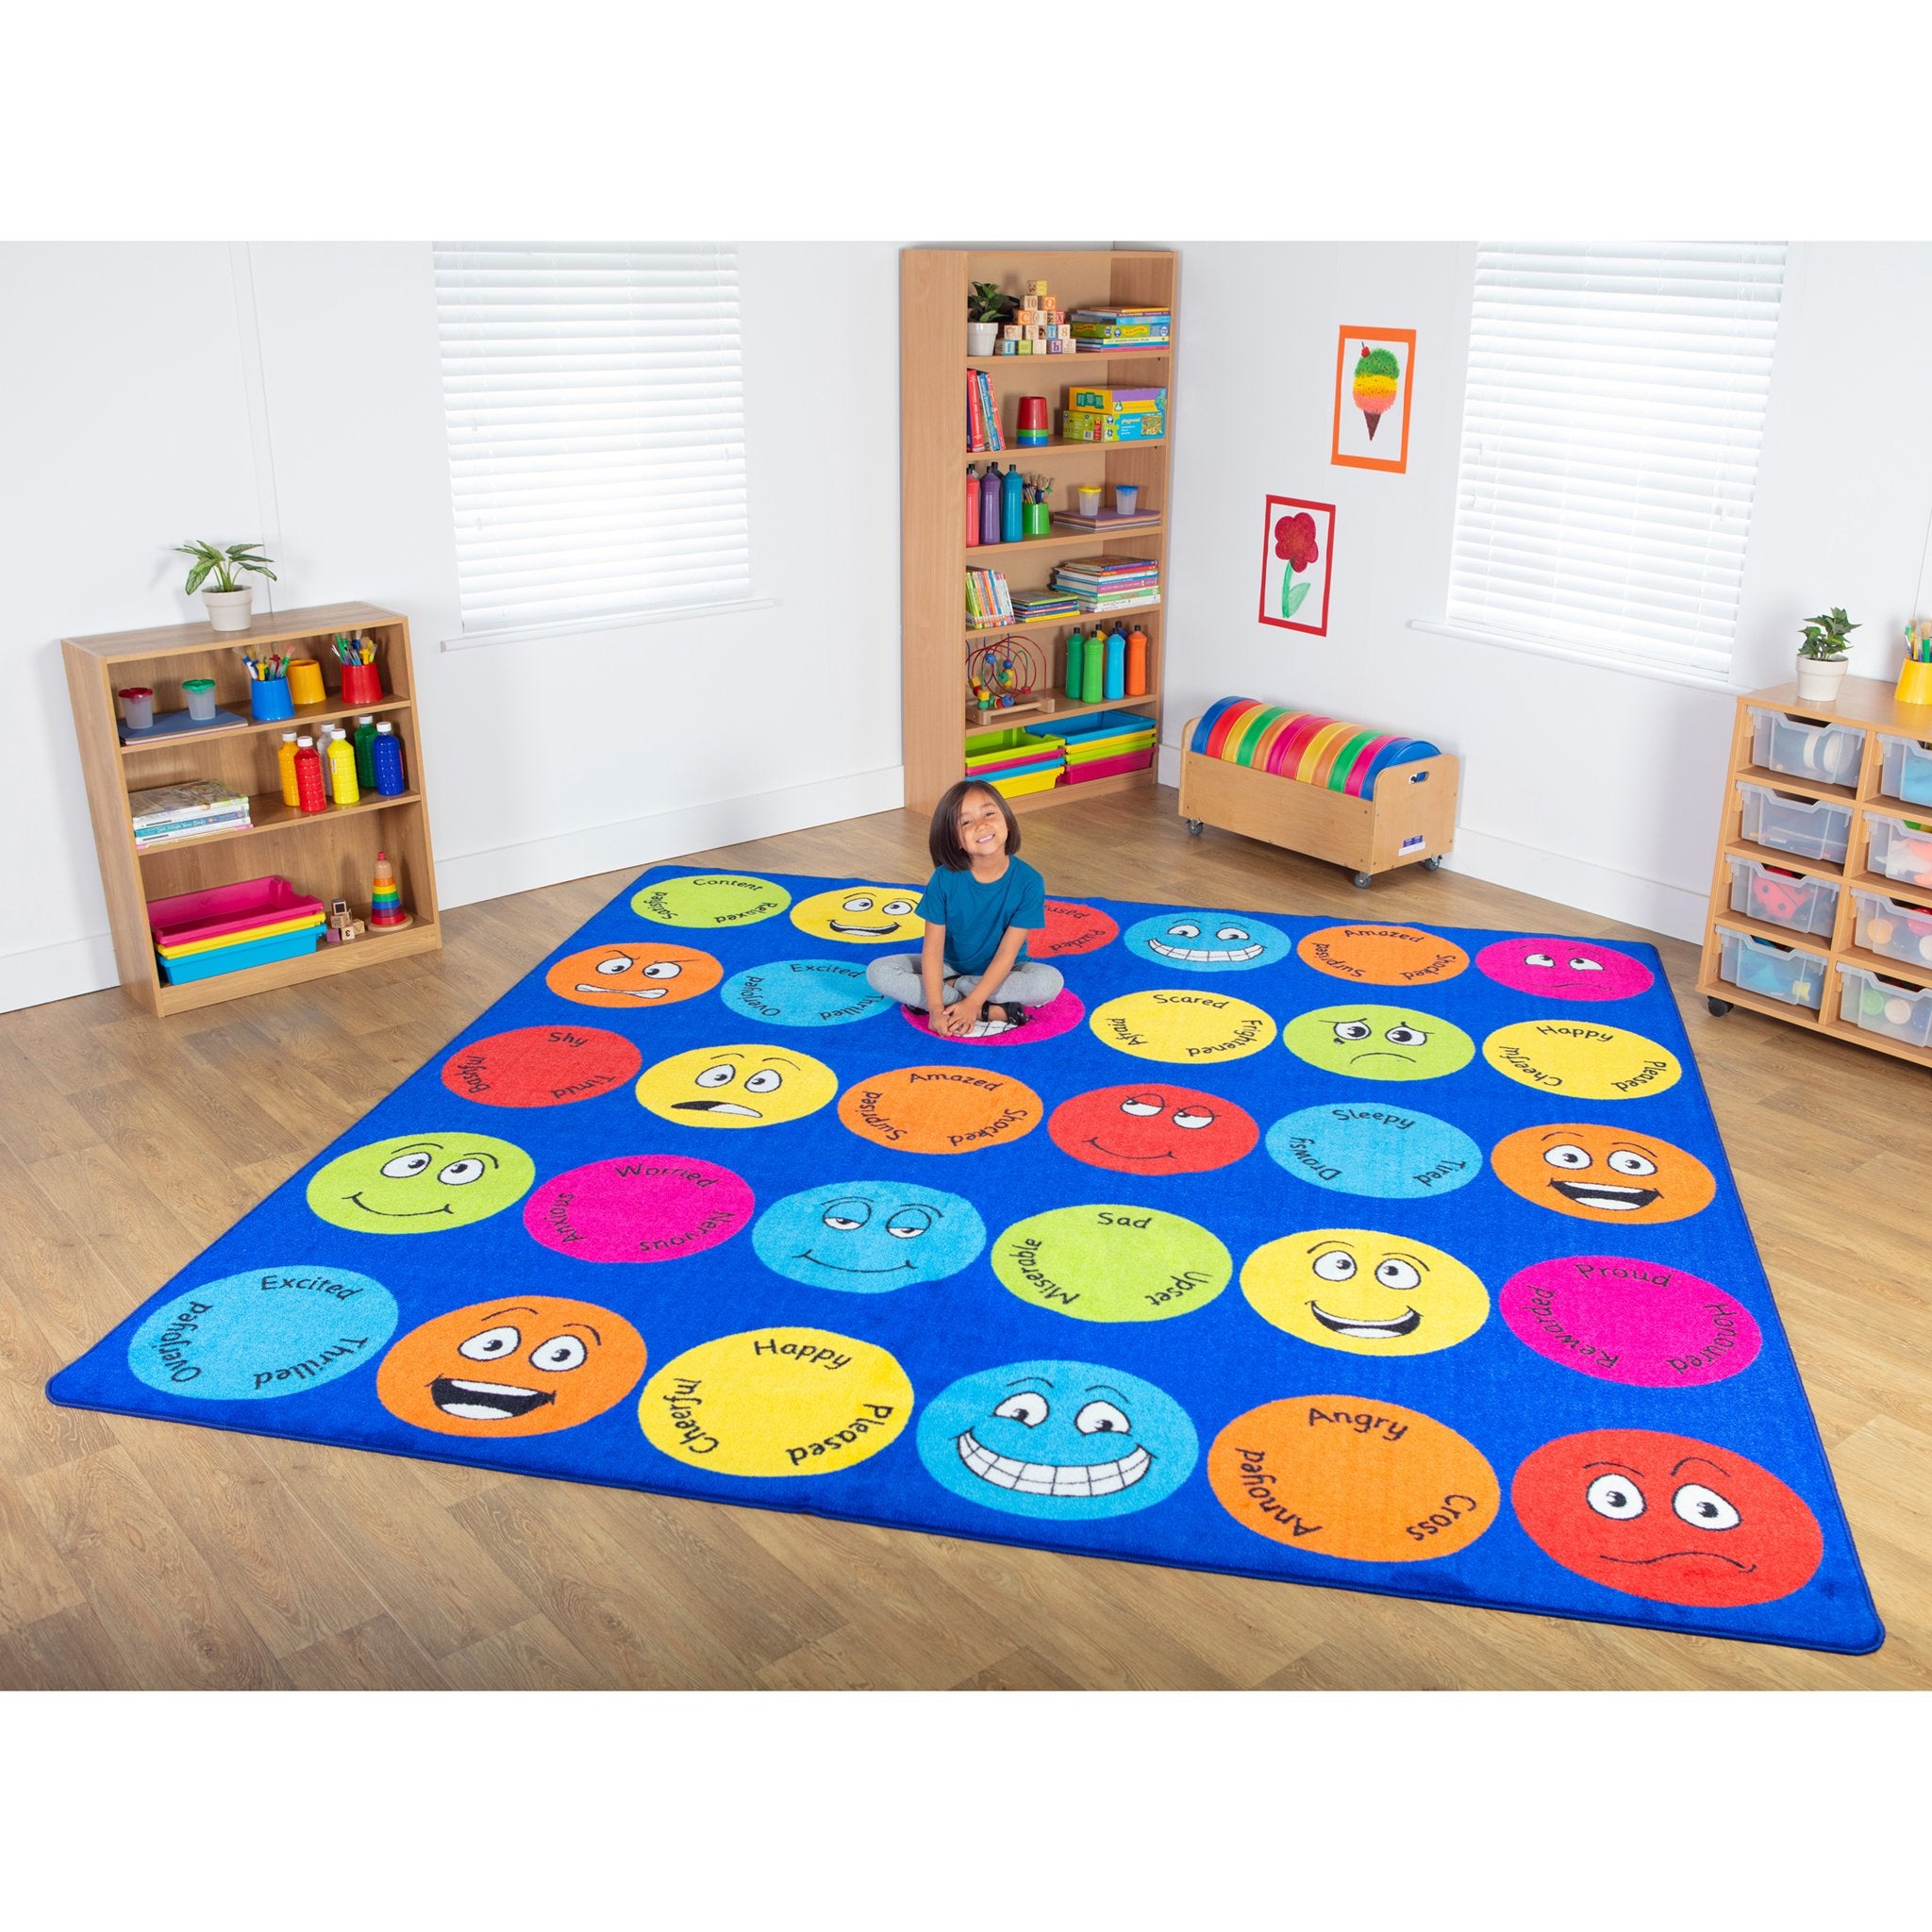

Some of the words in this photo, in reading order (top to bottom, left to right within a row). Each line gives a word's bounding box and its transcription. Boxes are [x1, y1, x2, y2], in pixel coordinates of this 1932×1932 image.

[693, 878, 763, 891] Content
[643, 891, 678, 920] Satisfied
[714, 902, 778, 924] Relaxed
[1049, 929, 1106, 951] Puzzled
[1344, 929, 1424, 943] Amazed
[789, 963, 866, 978] Excited
[1311, 942, 1366, 977] Surprised
[1399, 954, 1457, 980] Shocked
[741, 975, 781, 1017] Overjoyed
[1153, 993, 1229, 1009] Scared
[547, 1031, 589, 1047] Shy
[1106, 1018, 1148, 1046] Afraid
[1186, 1019, 1263, 1057] Frightened
[1536, 1024, 1613, 1042] Happy
[457, 1055, 491, 1094] Bashful
[909, 1073, 1004, 1091] Amazed
[1499, 1045, 1563, 1087] Cheerful
[1610, 1060, 1667, 1092] Pleased
[550, 1074, 616, 1100] Timid
[855, 1091, 908, 1141] Surprised
[947, 1108, 1028, 1147] Shocked
[1332, 1108, 1415, 1130] Sleepy
[1290, 1136, 1341, 1181] Drowsy
[1413, 1159, 1466, 1187] Tired
[614, 1162, 720, 1189] Worried
[543, 1192, 589, 1244] Anxious
[639, 1210, 736, 1252] Nervous
[1097, 1212, 1153, 1229] Sad
[260, 1274, 364, 1301] Excited
[1009, 1238, 1081, 1306] Miserable
[1574, 1263, 1673, 1288] Proud
[1144, 1271, 1213, 1307] Upset
[151, 1301, 214, 1383] Overjoyed
[1522, 1285, 1620, 1369] Rewarded
[1666, 1303, 1738, 1374] Honoured
[253, 1336, 370, 1390] Thrilled
[753, 1338, 852, 1370] Happy
[663, 1377, 720, 1454] Cheerful
[1307, 1407, 1408, 1441] Angry
[786, 1403, 894, 1466] Pleased
[1234, 1448, 1324, 1537] Annoyed
[1406, 1493, 1477, 1541] Cross
